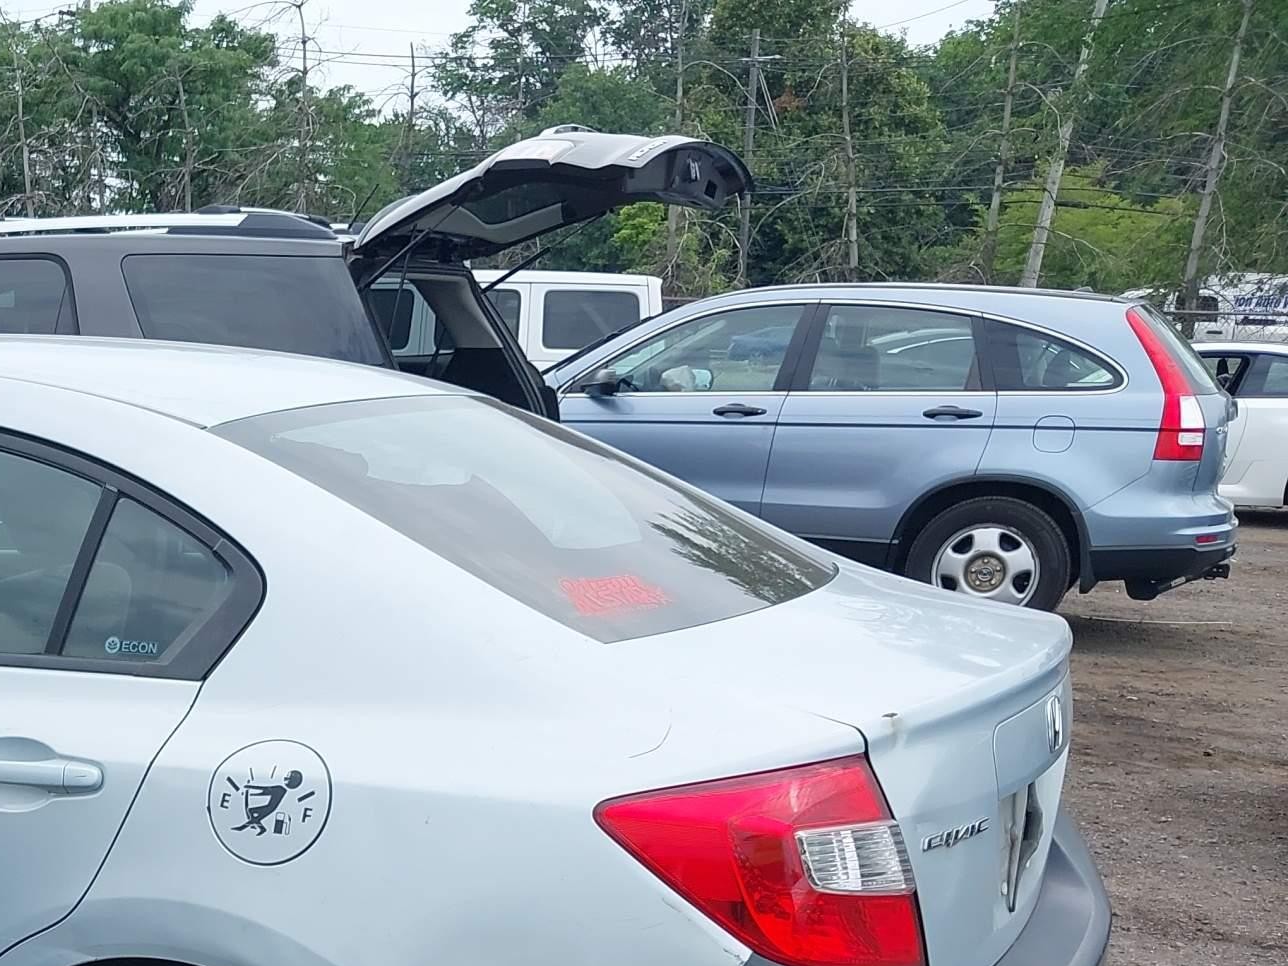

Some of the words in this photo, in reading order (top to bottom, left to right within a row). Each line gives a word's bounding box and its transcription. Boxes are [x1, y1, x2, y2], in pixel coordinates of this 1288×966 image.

[121, 640, 158, 654] ECON
[219, 792, 232, 809] E
[300, 807, 313, 823] F
[920, 816, 991, 852] CIVIC
